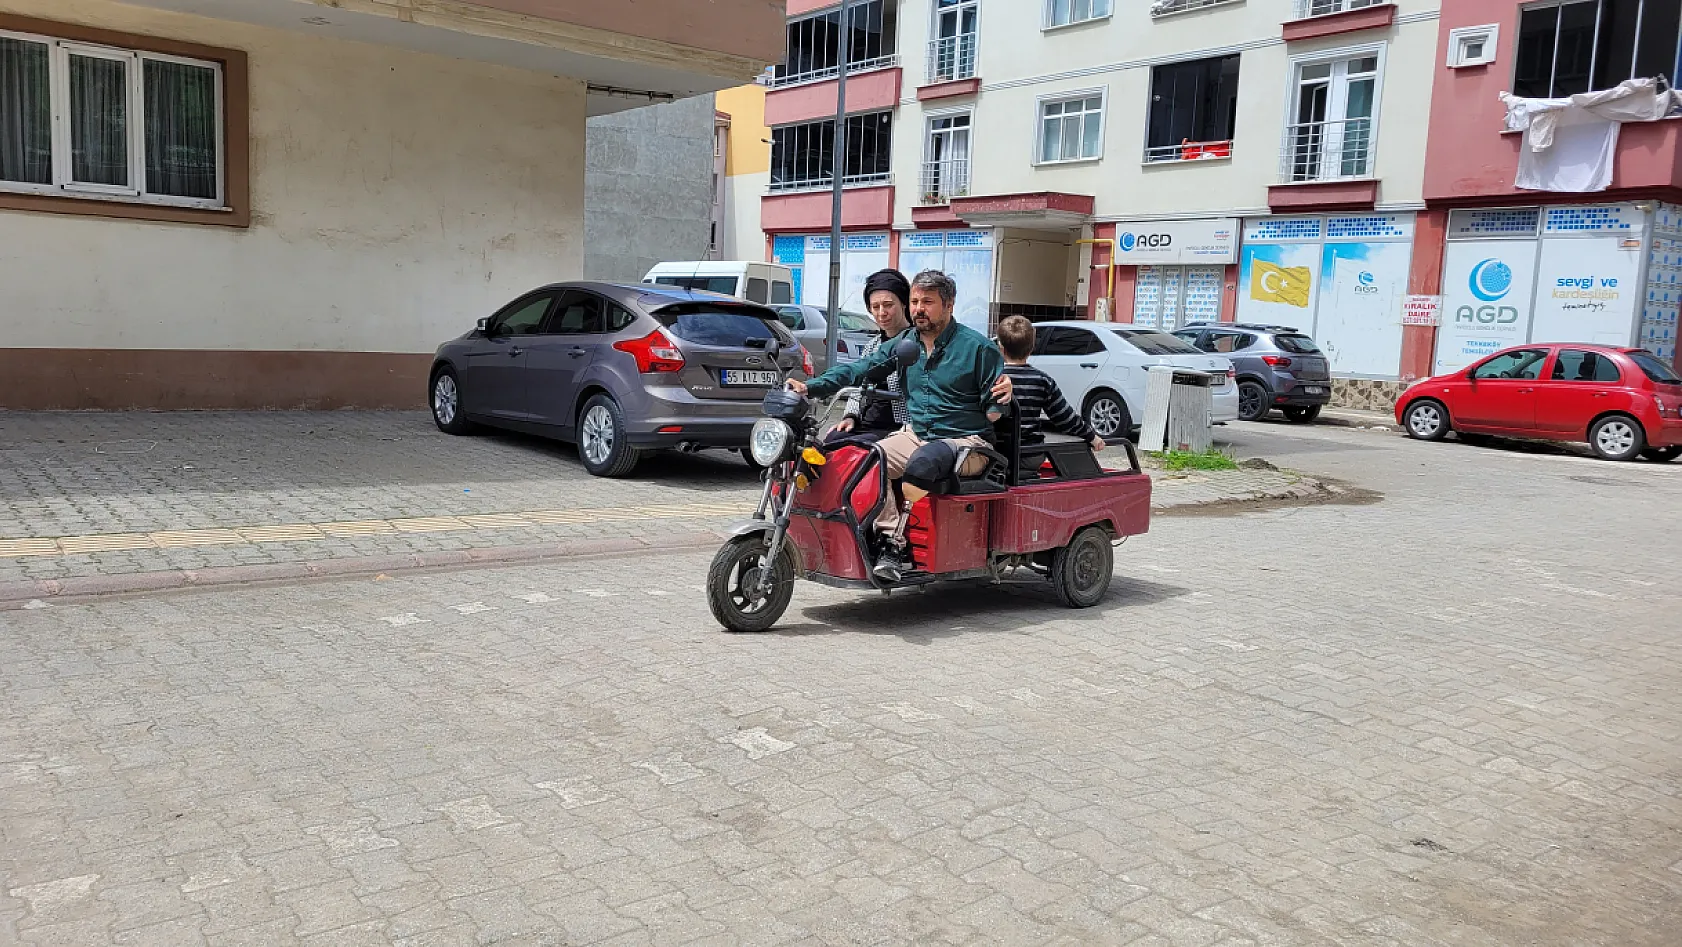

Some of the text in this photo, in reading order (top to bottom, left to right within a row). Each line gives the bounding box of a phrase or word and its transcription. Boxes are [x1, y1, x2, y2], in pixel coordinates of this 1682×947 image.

[1136, 233, 1172, 248] AGD
[1556, 275, 1618, 289] sevgi ve
[1455, 304, 1519, 324] AGD
[727, 371, 739, 383] 55
